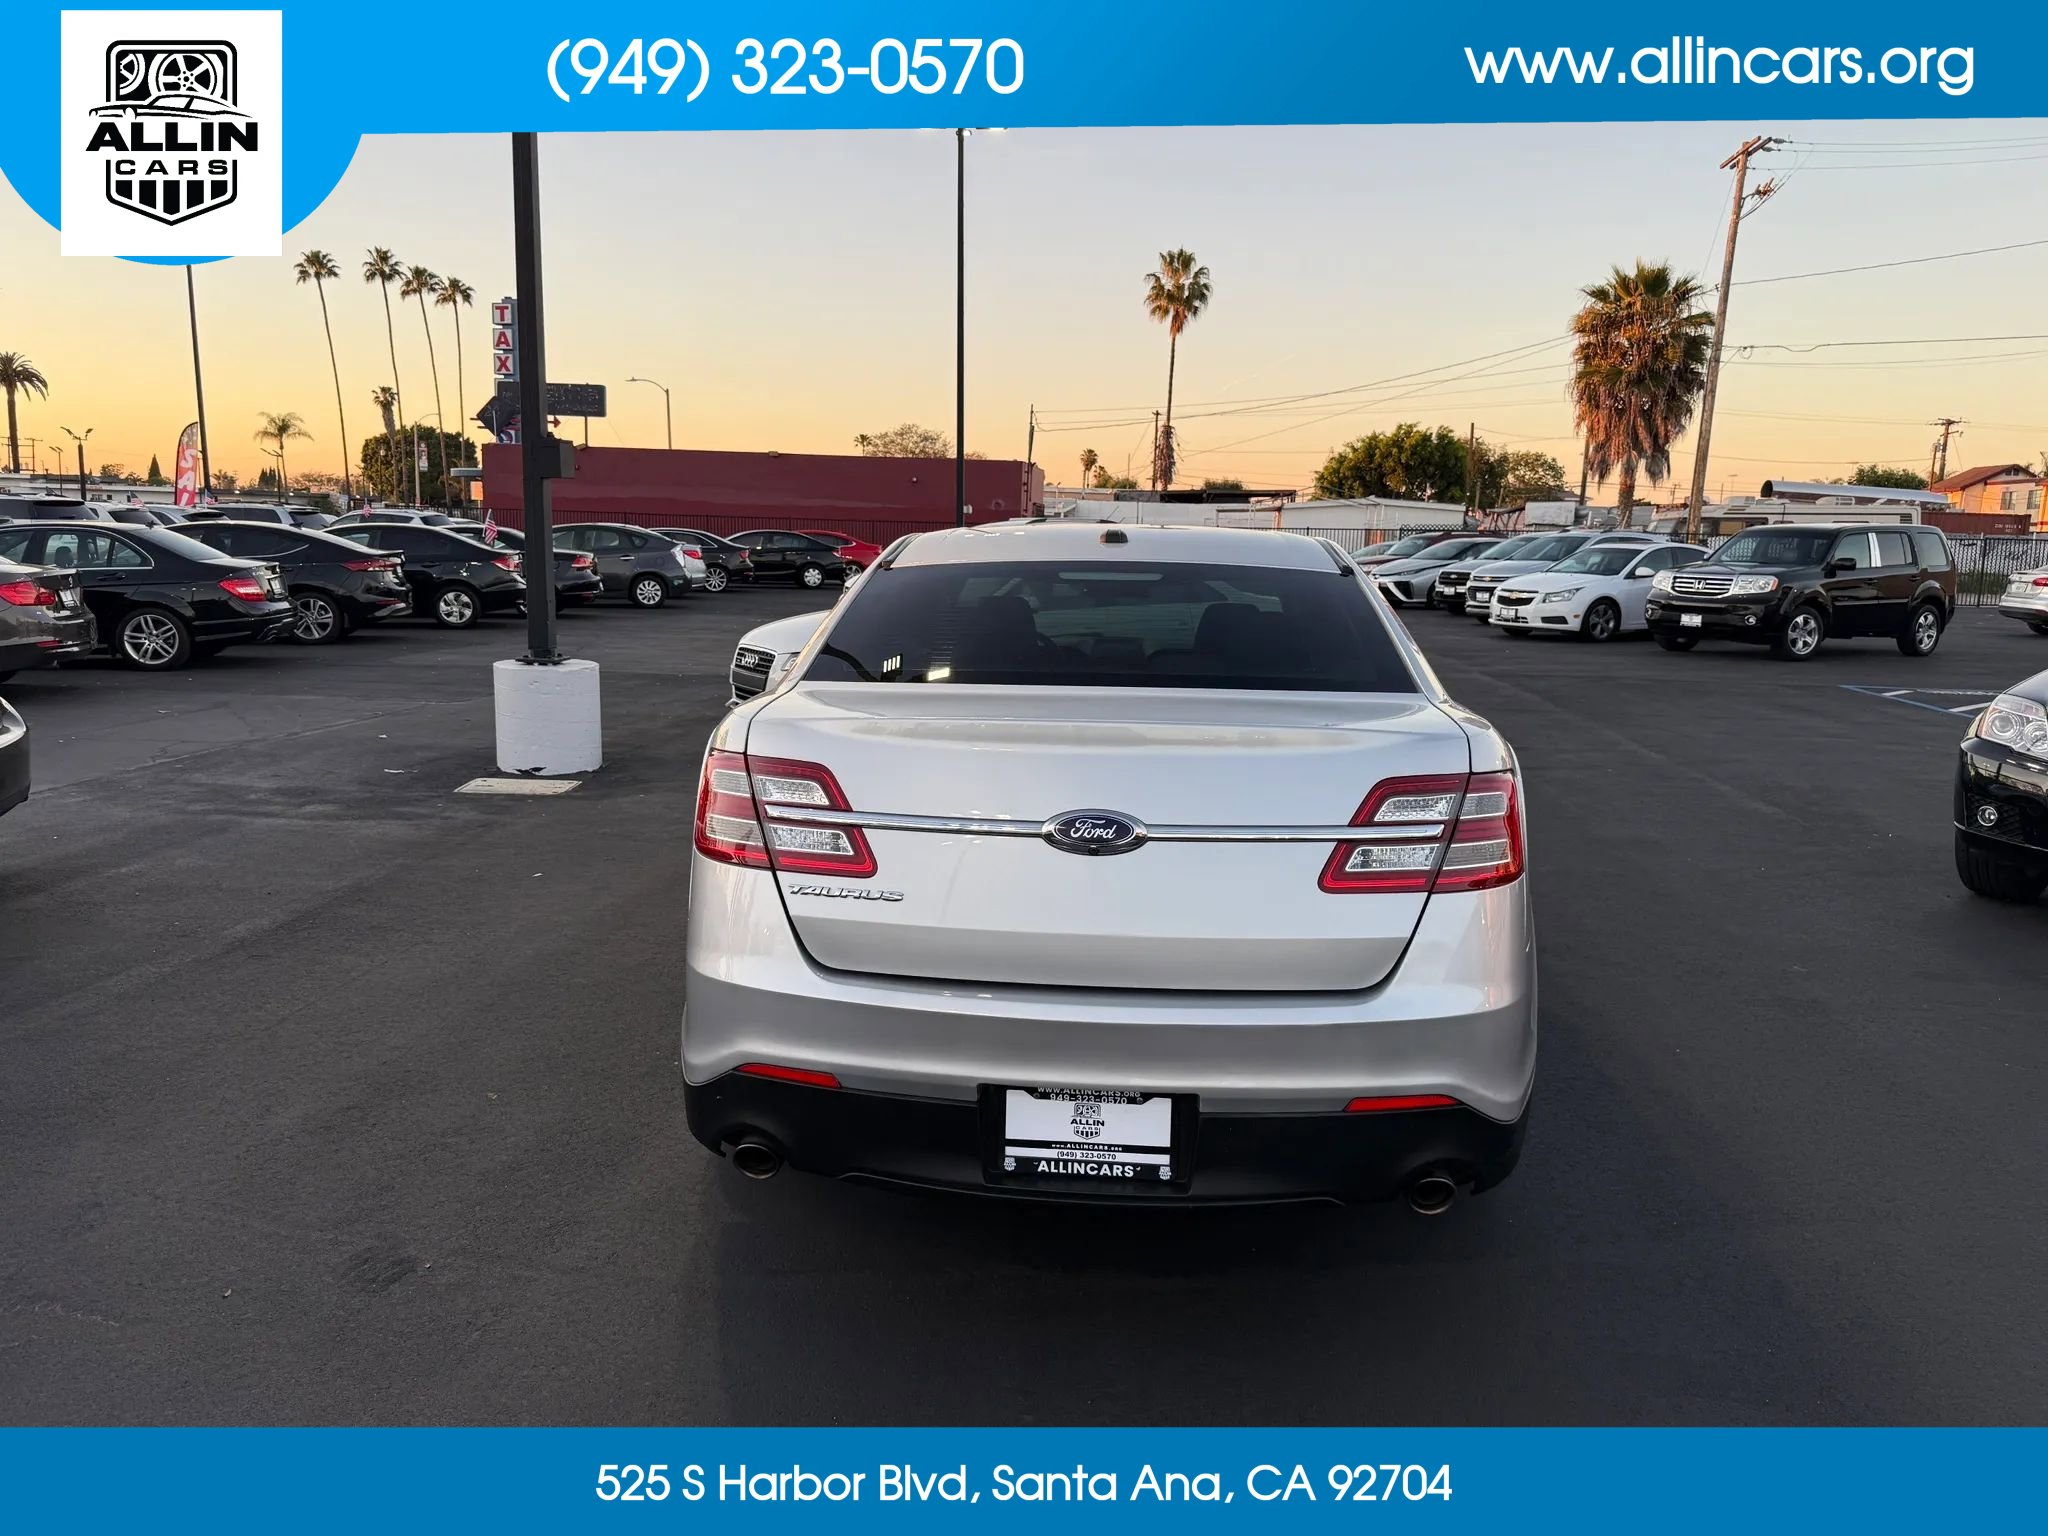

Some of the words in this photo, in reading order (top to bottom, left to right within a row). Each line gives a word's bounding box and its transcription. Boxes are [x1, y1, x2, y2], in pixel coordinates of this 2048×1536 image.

[494, 305, 511, 372] TAX
[1070, 818, 1117, 839] Ford
[788, 883, 904, 902] TAURUS
[1050, 1093, 1128, 1105] 949-323-0570
[1070, 1118, 1105, 1127] ALLIN
[1056, 1150, 1078, 1159] (949)
[1079, 1152, 1117, 1161] 323-0570
[1037, 1160, 1134, 1178] ALLINCARS
